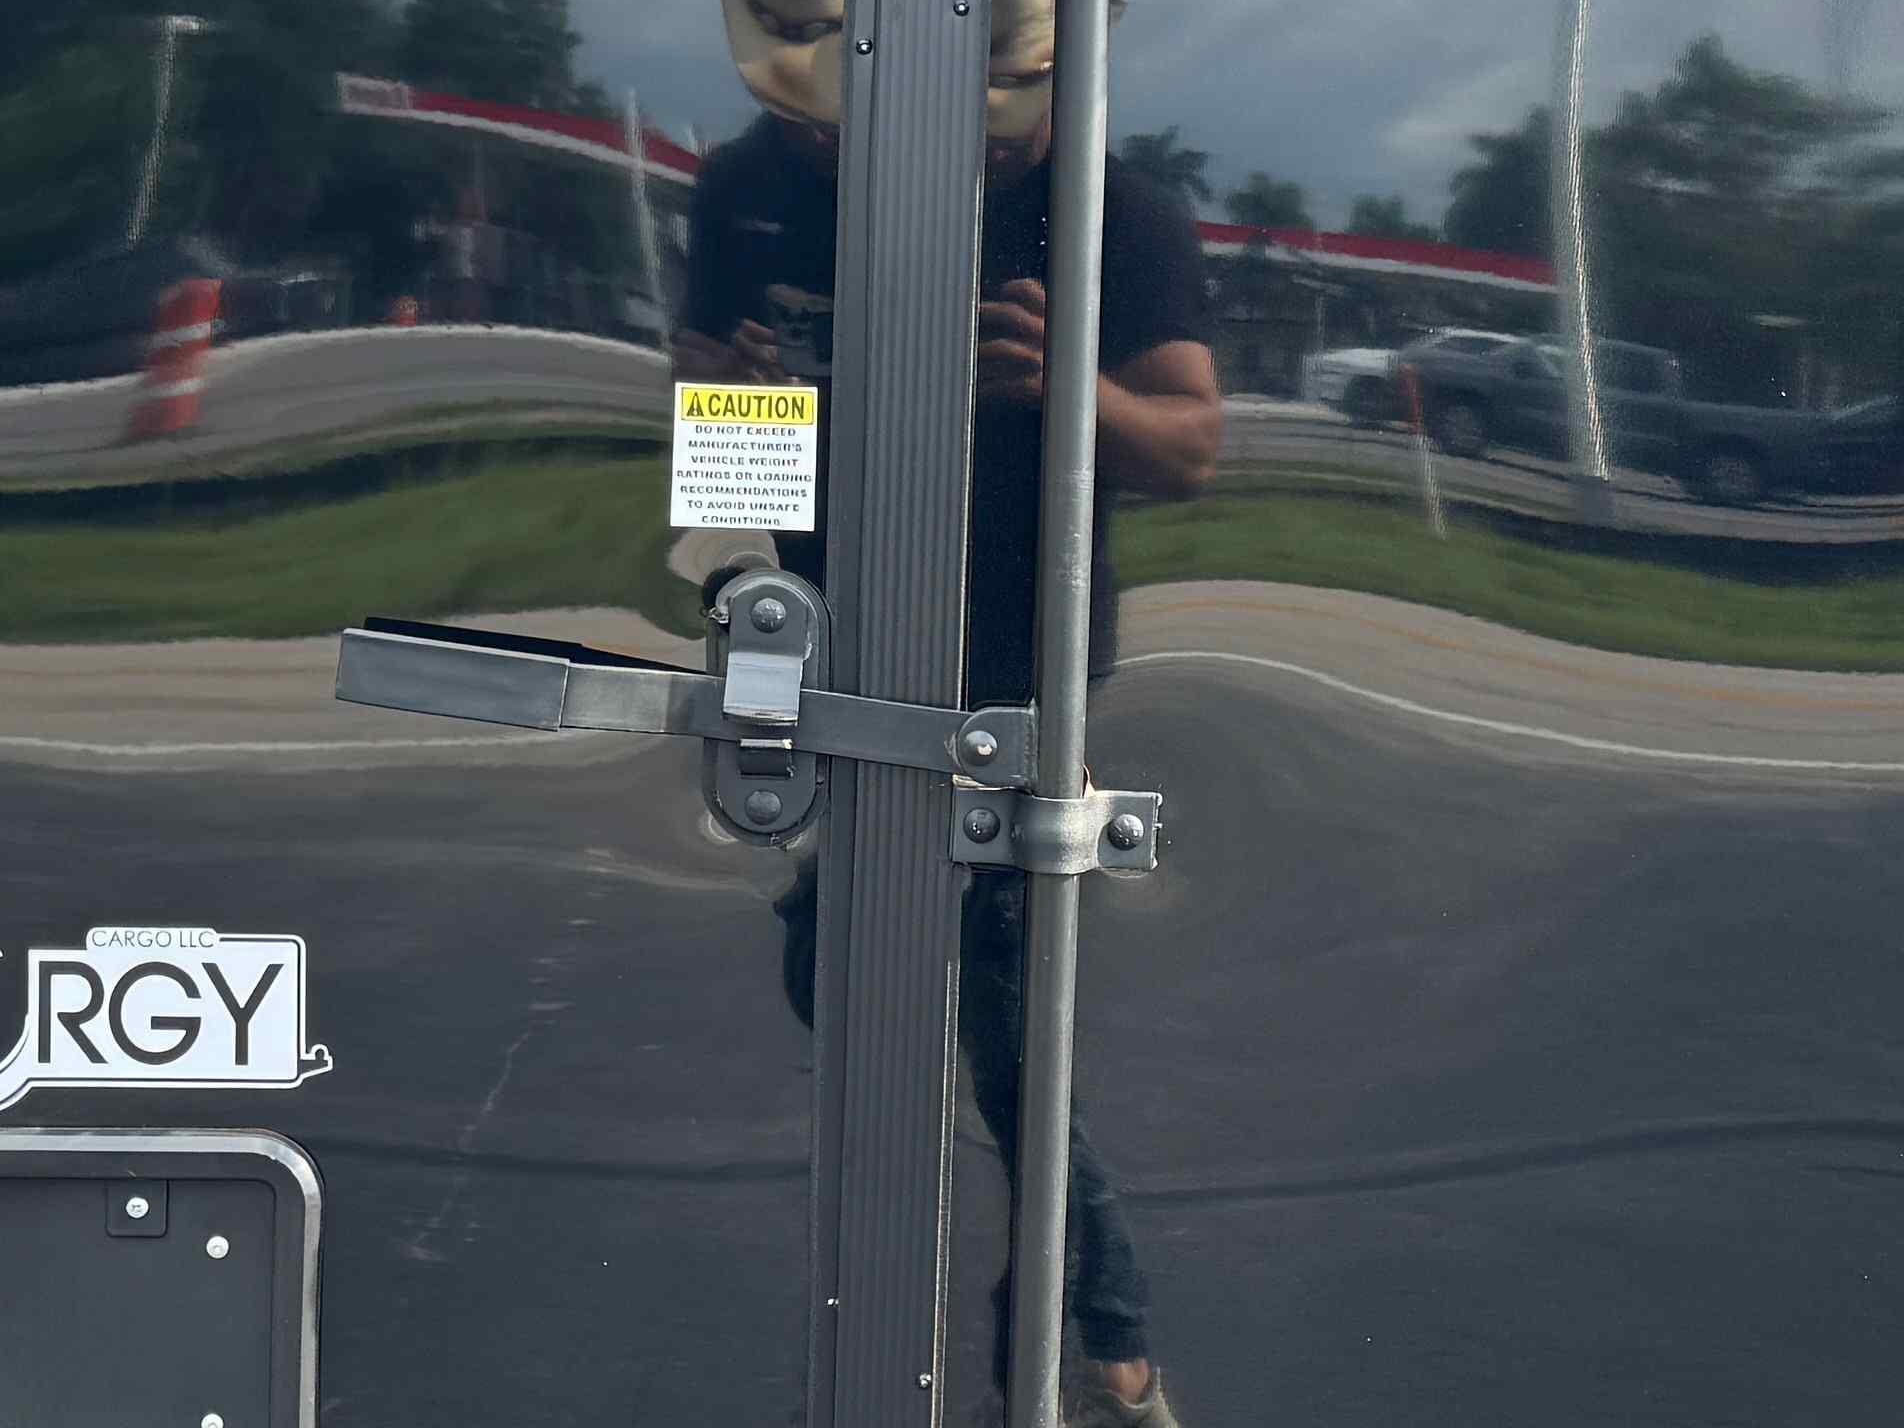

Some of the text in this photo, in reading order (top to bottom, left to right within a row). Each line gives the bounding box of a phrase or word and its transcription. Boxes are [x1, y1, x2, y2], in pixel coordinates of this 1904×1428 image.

[708, 393, 805, 420] CAUTION
[695, 424, 796, 437] DO NOT EXCEED
[687, 500, 703, 509] TO
[707, 500, 745, 510] AVOID
[92, 930, 214, 948] CARGO LLC
